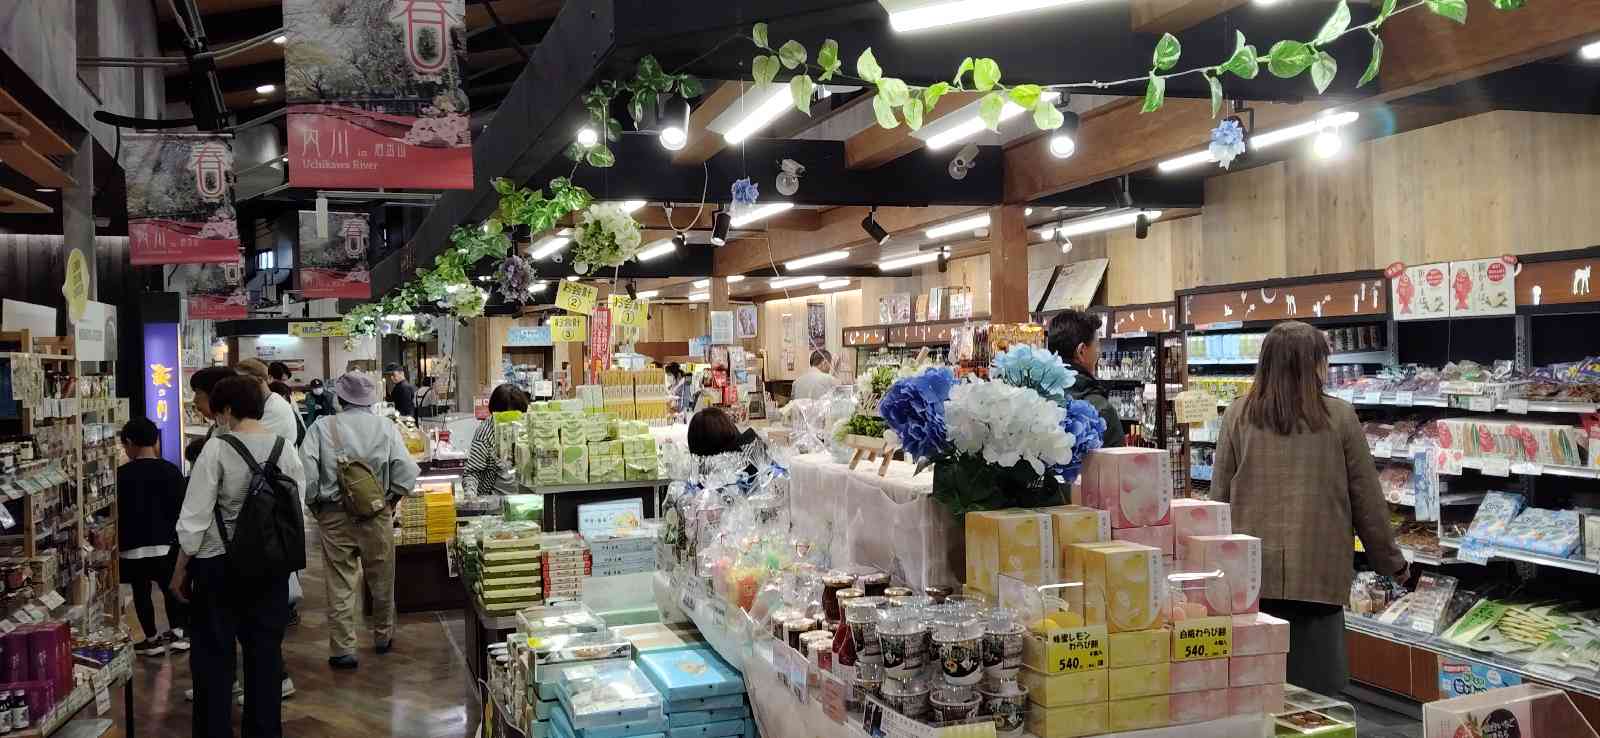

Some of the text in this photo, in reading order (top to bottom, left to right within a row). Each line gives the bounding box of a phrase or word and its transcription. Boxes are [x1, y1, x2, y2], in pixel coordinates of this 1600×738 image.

[191, 144, 226, 196] 春
[302, 160, 379, 170] Uchikawa River
[563, 281, 593, 298] お会計
[1185, 644, 1205, 658] 540
[1059, 657, 1080, 671] 540
